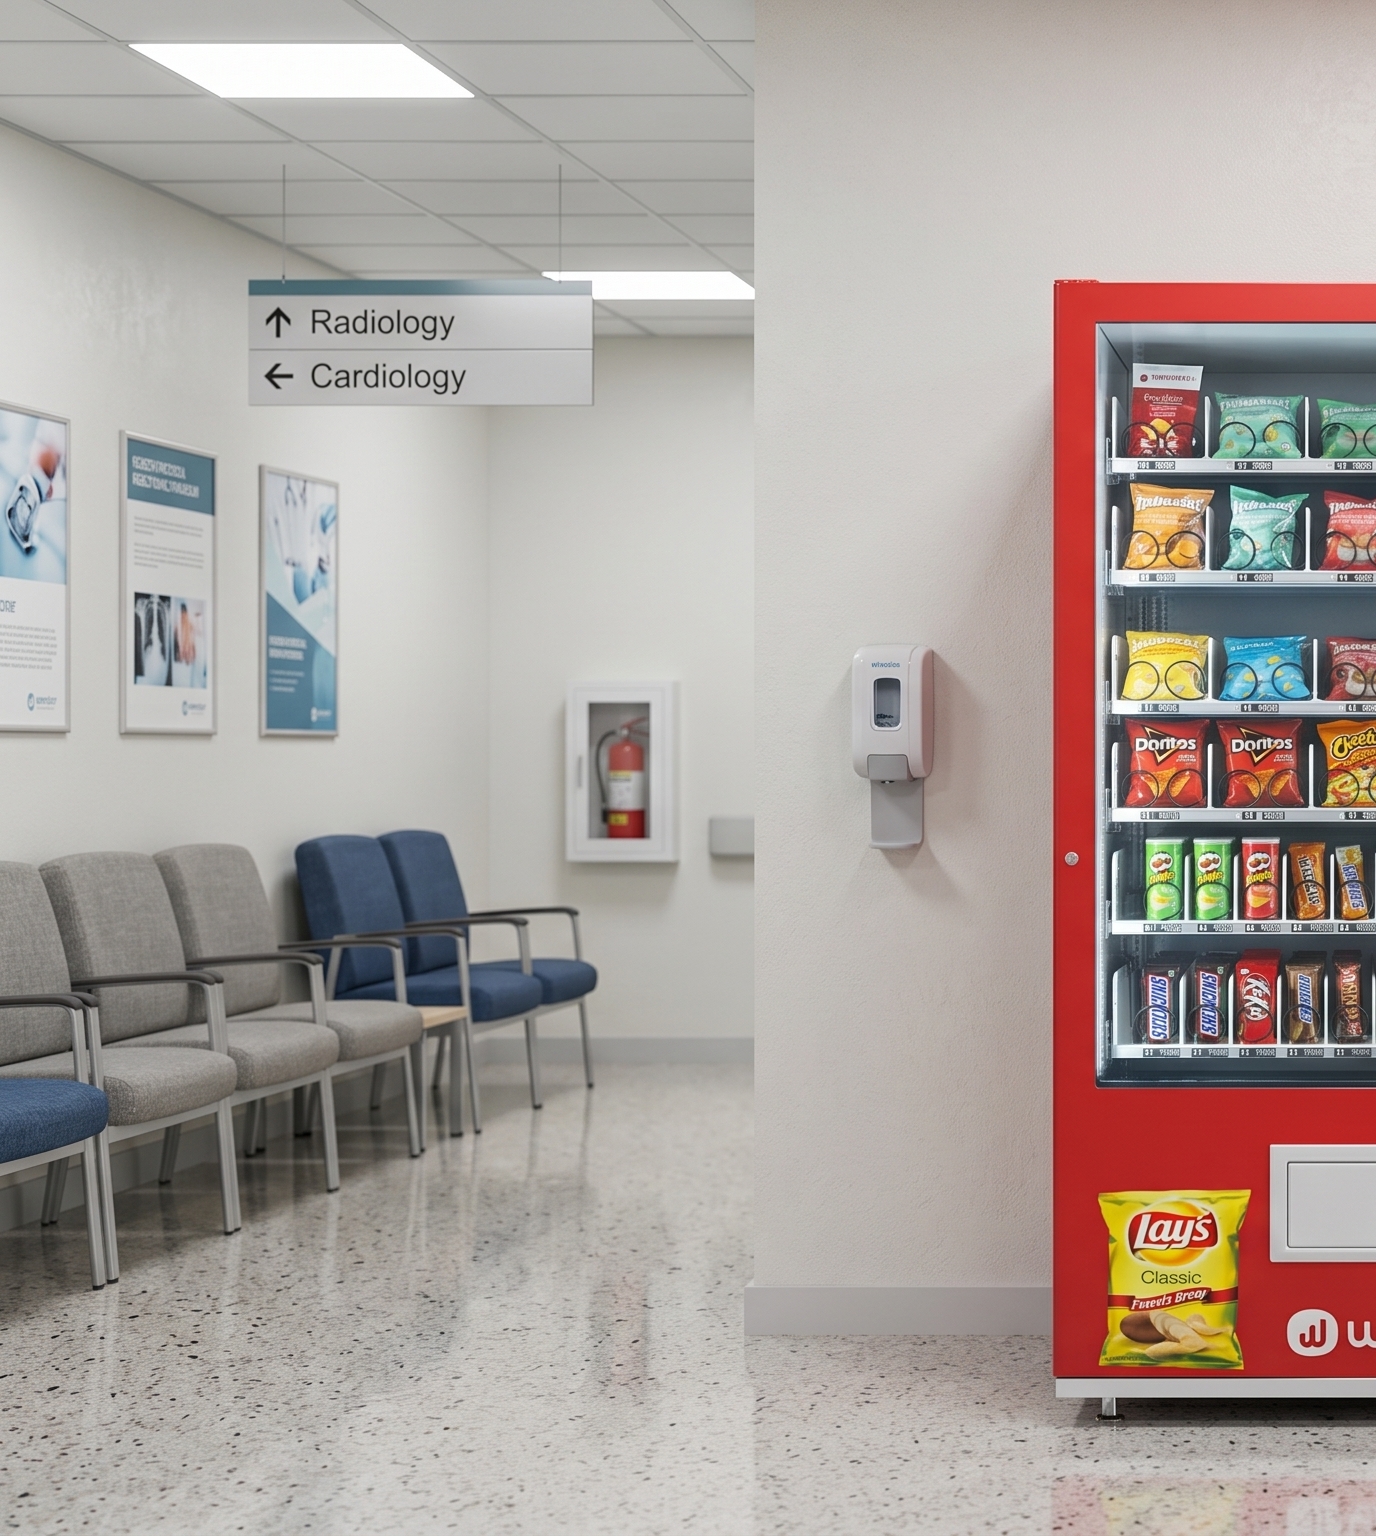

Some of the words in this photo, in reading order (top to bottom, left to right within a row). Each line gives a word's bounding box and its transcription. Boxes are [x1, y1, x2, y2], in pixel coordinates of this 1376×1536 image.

[312, 310, 454, 340] Radiology
[311, 363, 466, 395] Cardiology
[1135, 735, 1197, 752] Doritos
[1231, 735, 1293, 753] Doritos
[1134, 1212, 1213, 1250] Lay's
[1141, 1270, 1202, 1285] Classic
